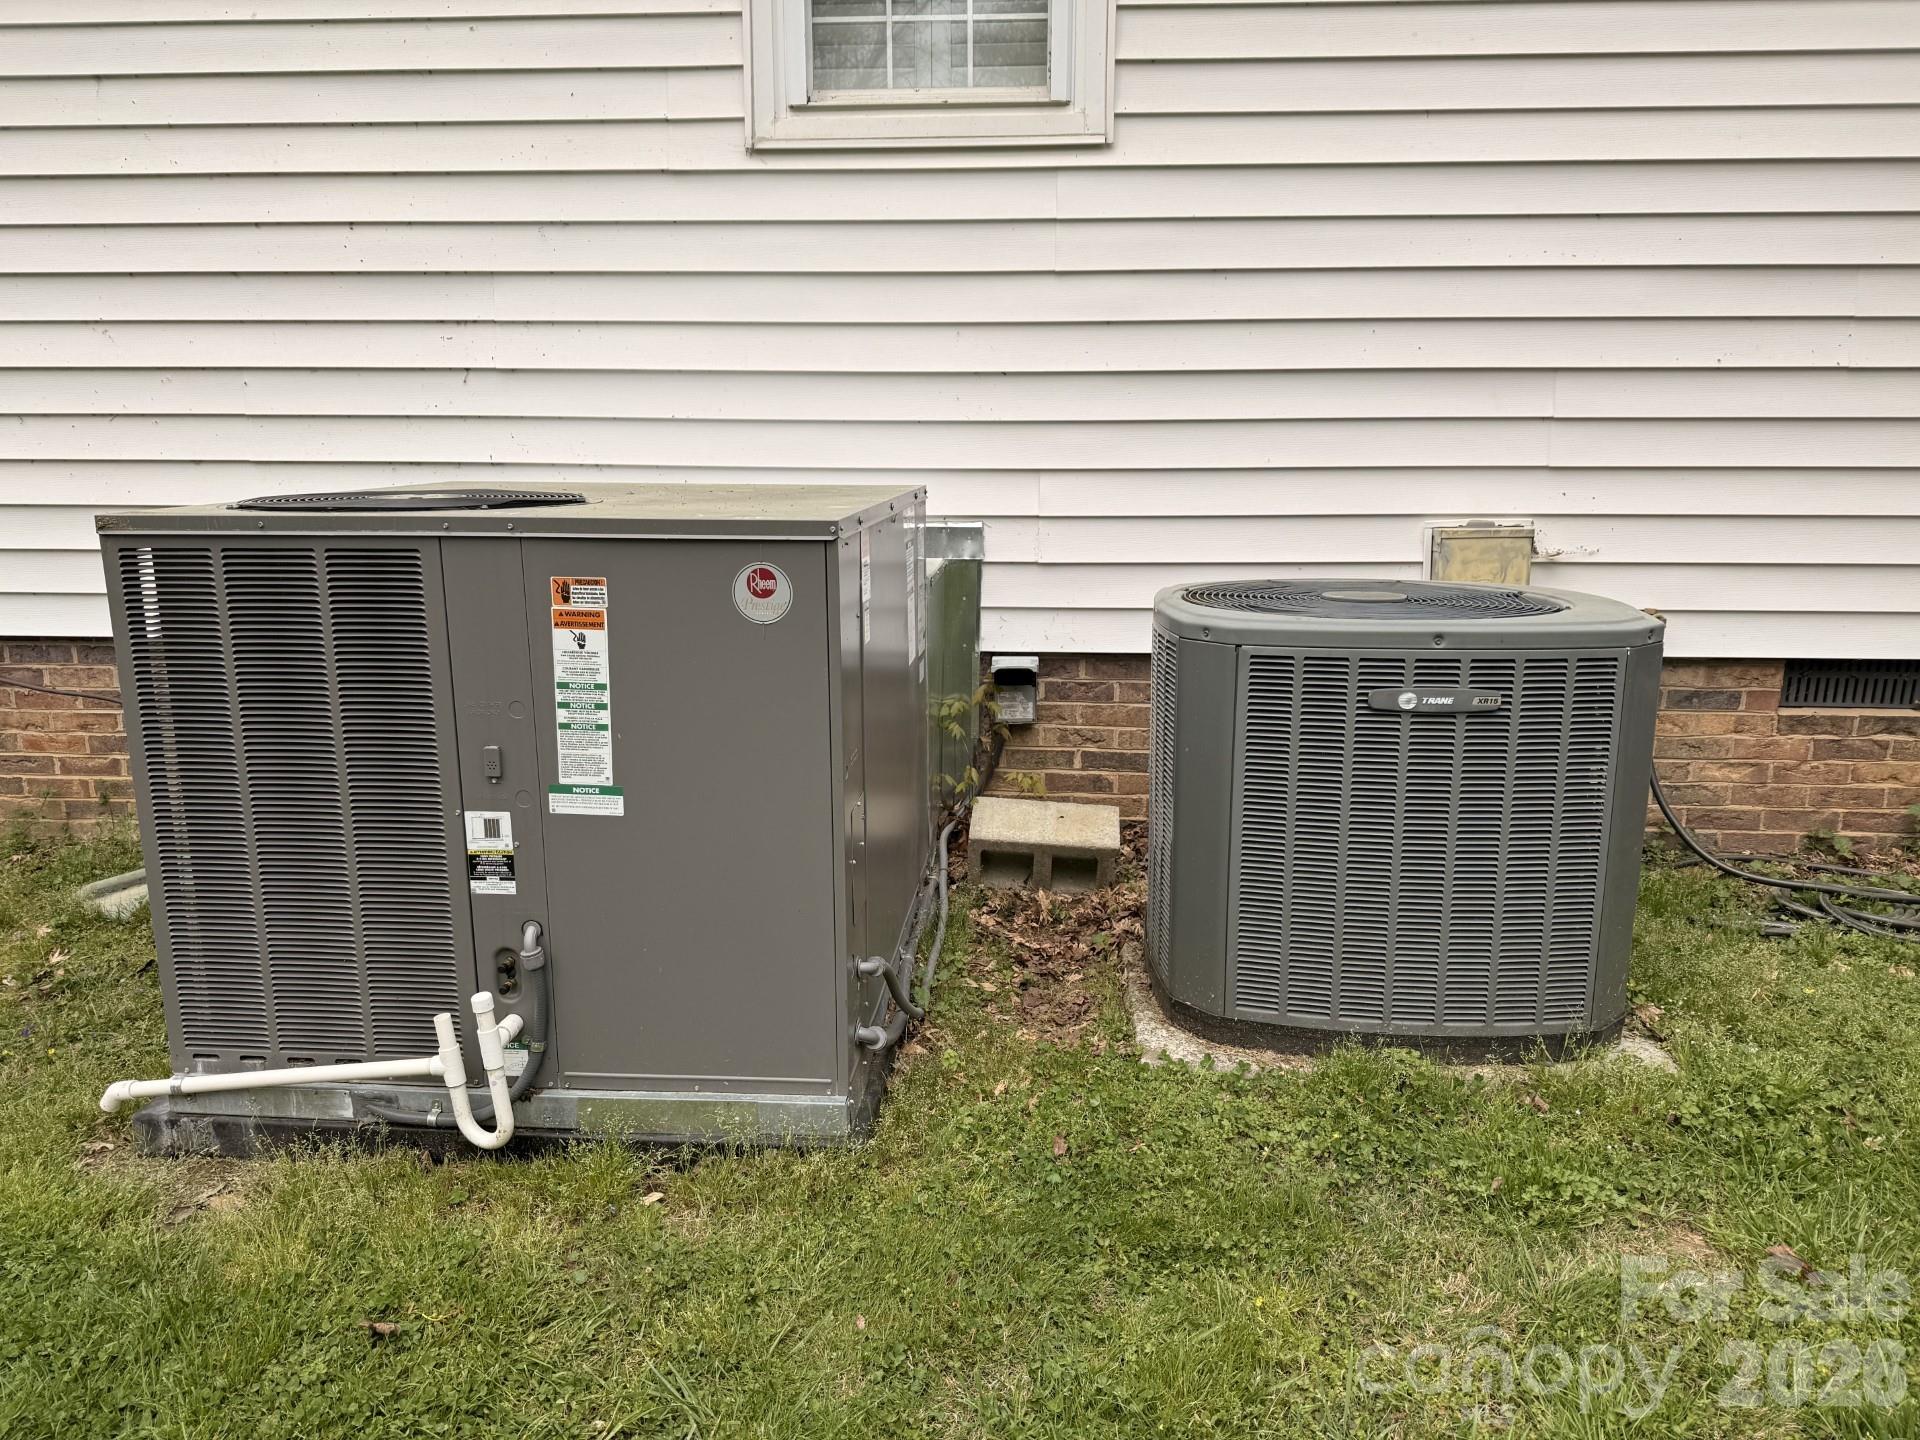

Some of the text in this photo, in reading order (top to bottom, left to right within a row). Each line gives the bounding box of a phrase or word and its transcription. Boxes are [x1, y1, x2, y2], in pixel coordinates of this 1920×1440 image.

[749, 568, 777, 594] Rheem
[564, 611, 601, 619] WARNING
[560, 621, 605, 629] AVERTISSEMENT
[1422, 696, 1455, 705] TRANE
[570, 702, 595, 710] NOTICE
[572, 786, 600, 794] NOTICE
